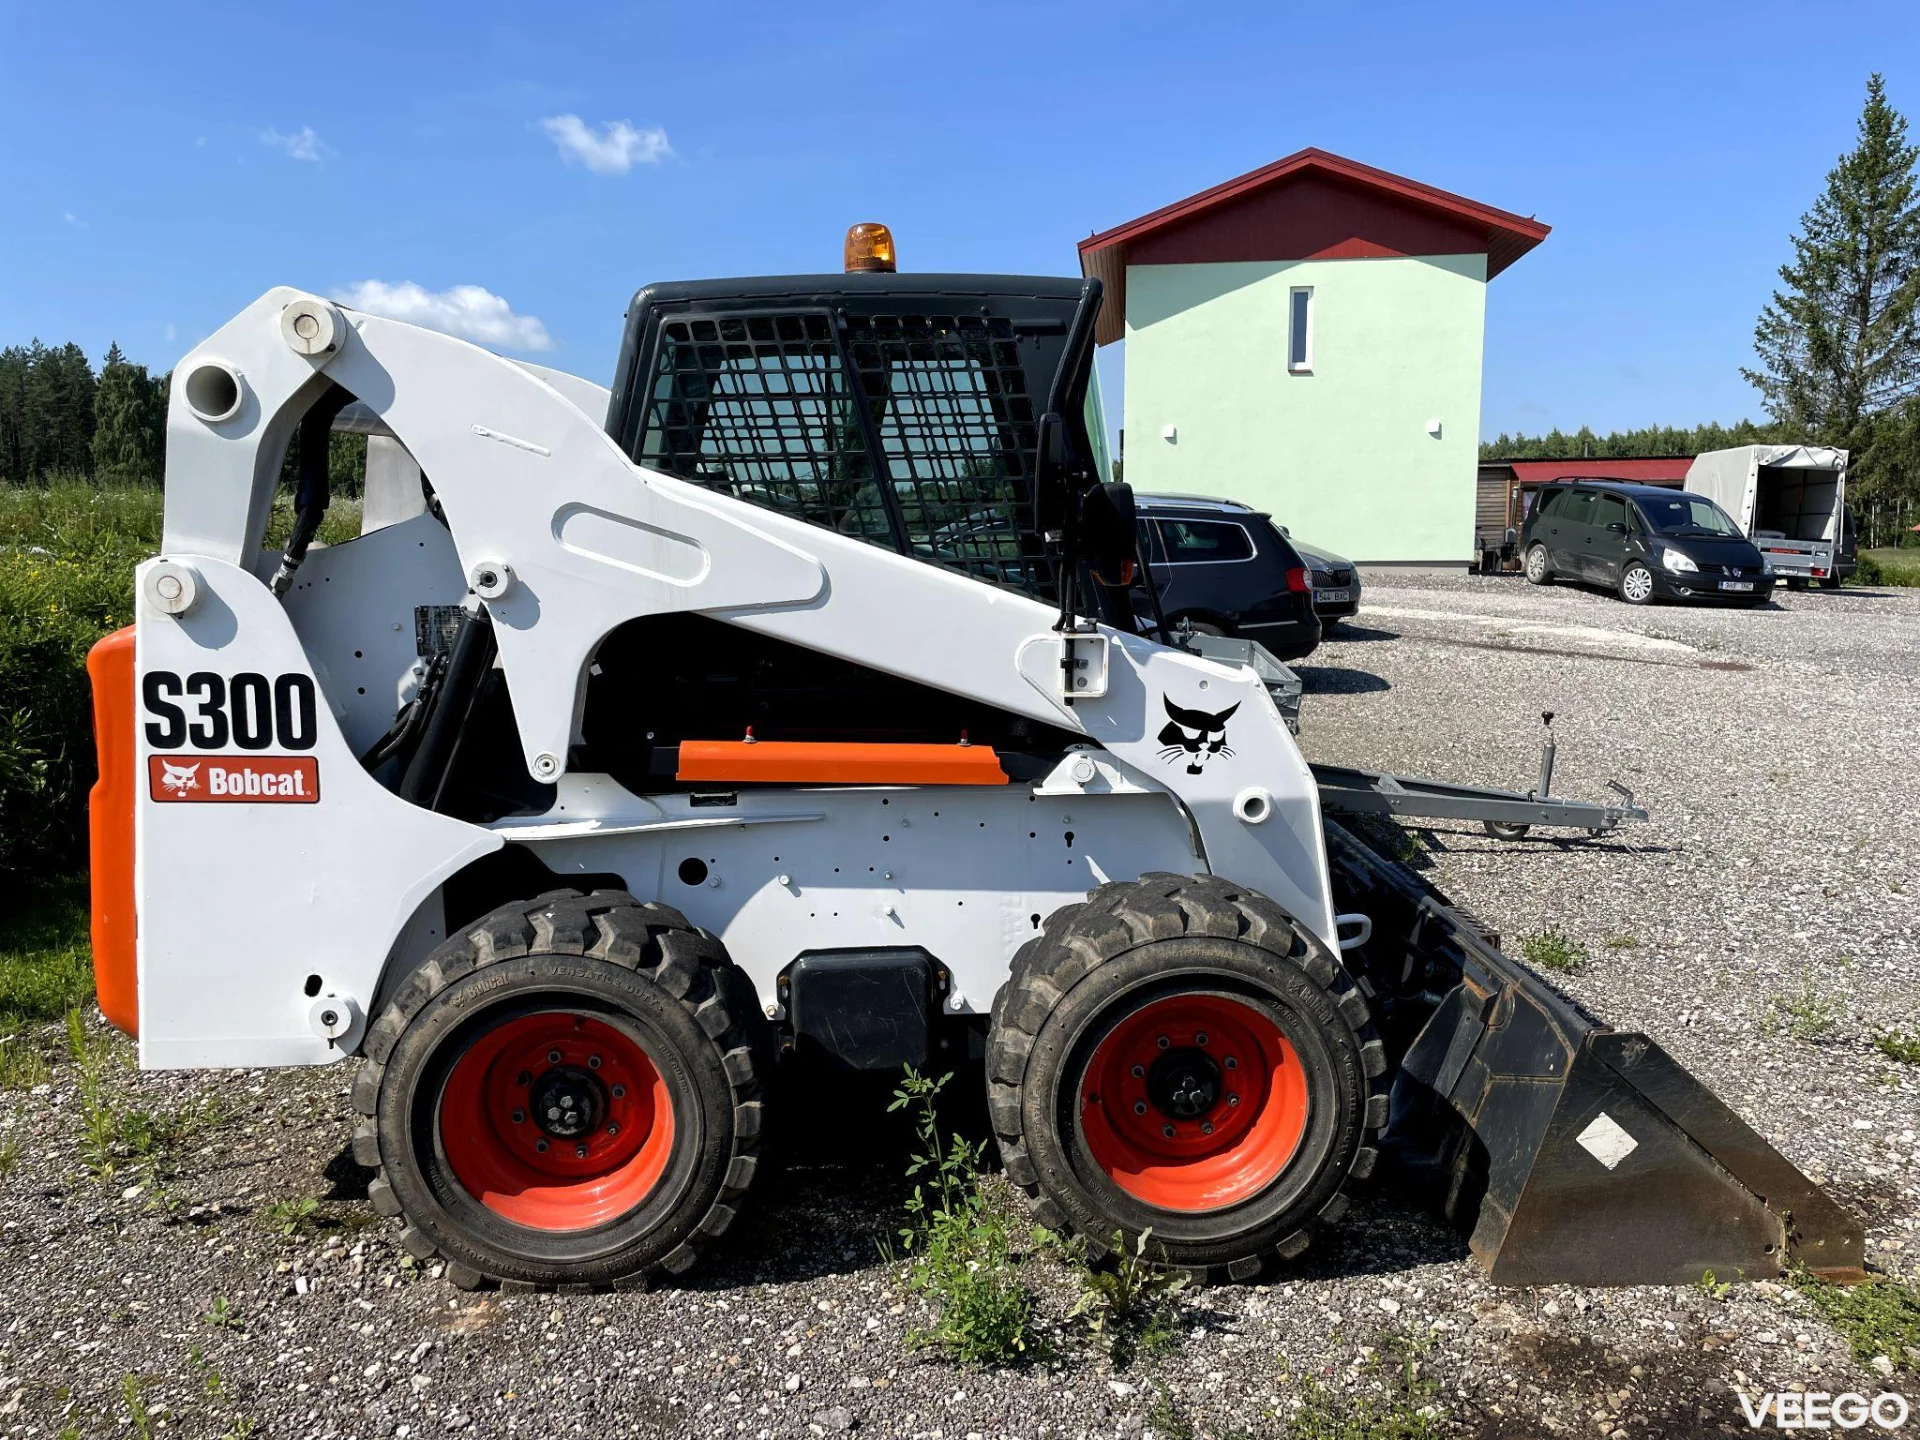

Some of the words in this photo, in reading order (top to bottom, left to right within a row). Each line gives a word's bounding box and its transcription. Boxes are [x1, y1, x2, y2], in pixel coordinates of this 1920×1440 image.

[142, 670, 317, 751] S300
[208, 767, 305, 796] Bobcat
[467, 971, 511, 1001] Bobcat
[548, 965, 622, 989] VERSATILE
[624, 982, 659, 1007] DUTY
